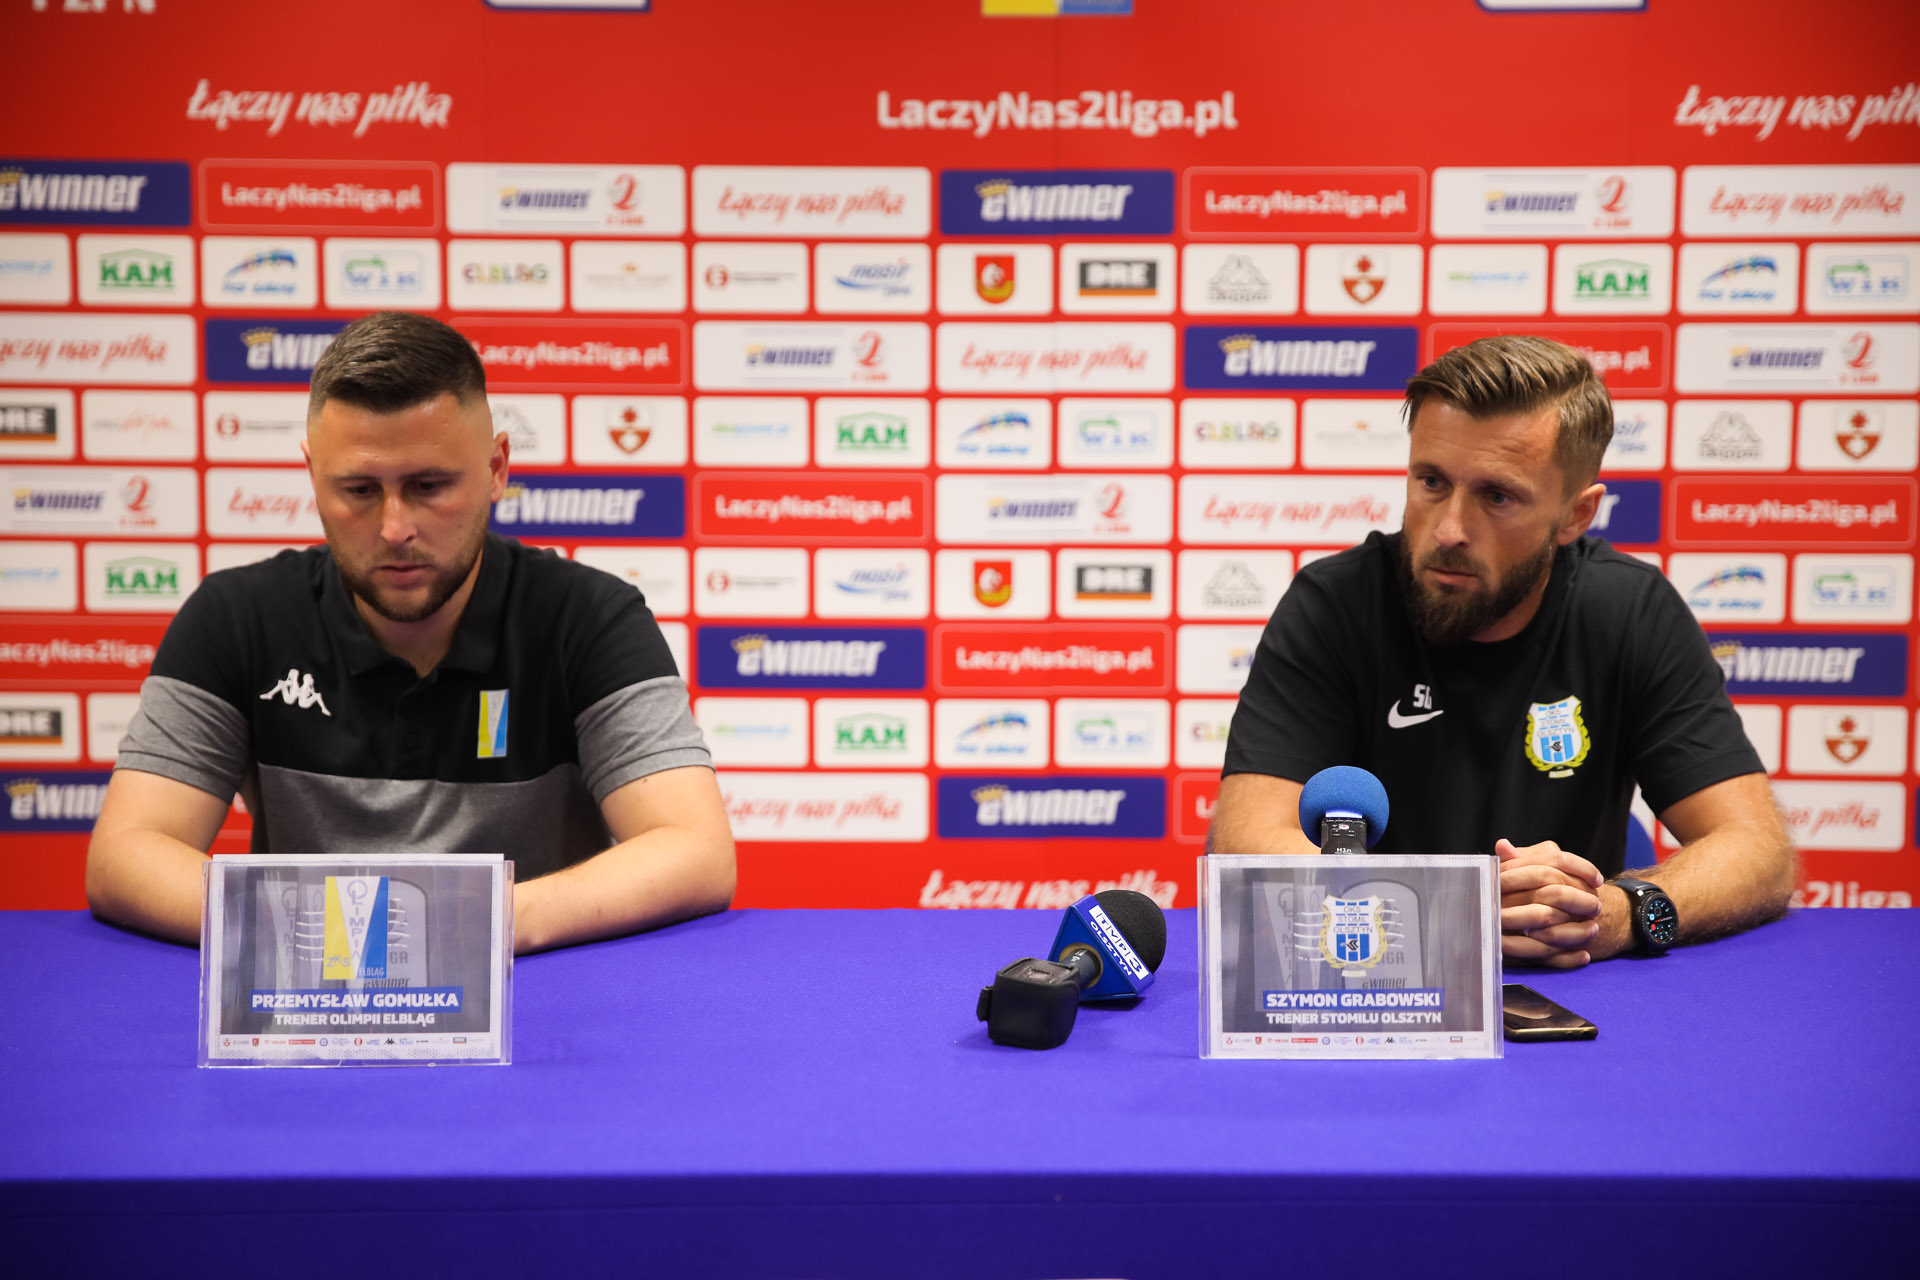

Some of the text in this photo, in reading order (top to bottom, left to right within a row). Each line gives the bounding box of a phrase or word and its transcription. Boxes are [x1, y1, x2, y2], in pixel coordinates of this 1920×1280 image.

[187, 78, 452, 139] Łączy nas piłka
[877, 91, 1238, 138] LaczyNas2liga.pl
[1674, 84, 1787, 142] Łączy
[1786, 95, 1856, 130] nas
[222, 182, 421, 213] LaczyNas2liga.pl
[980, 184, 1134, 221] ewinner
[1205, 190, 1407, 220] LaczyNas2liga.pl
[1224, 340, 1376, 377] ewinner
[495, 488, 645, 525] ewinner
[715, 494, 913, 524] LaczyNas2liga.pl
[1692, 499, 1898, 528] LaczyNas2liga.pl
[736, 640, 886, 677] ewinner
[956, 646, 1154, 675] LaczyNas2liga.pl
[975, 788, 1126, 826] ewinner
[1090, 921, 1132, 976] OLSZTYN
[252, 992, 459, 1008] PRZEMYSŁAW GOMUŁKA
[1266, 992, 1440, 1007] SZYMON GRABOWSKI
[274, 1013, 435, 1027] TRENER OLIMPII ELBLĄG
[1266, 1012, 1442, 1024] TRENER STOMILU OLSZTYN
